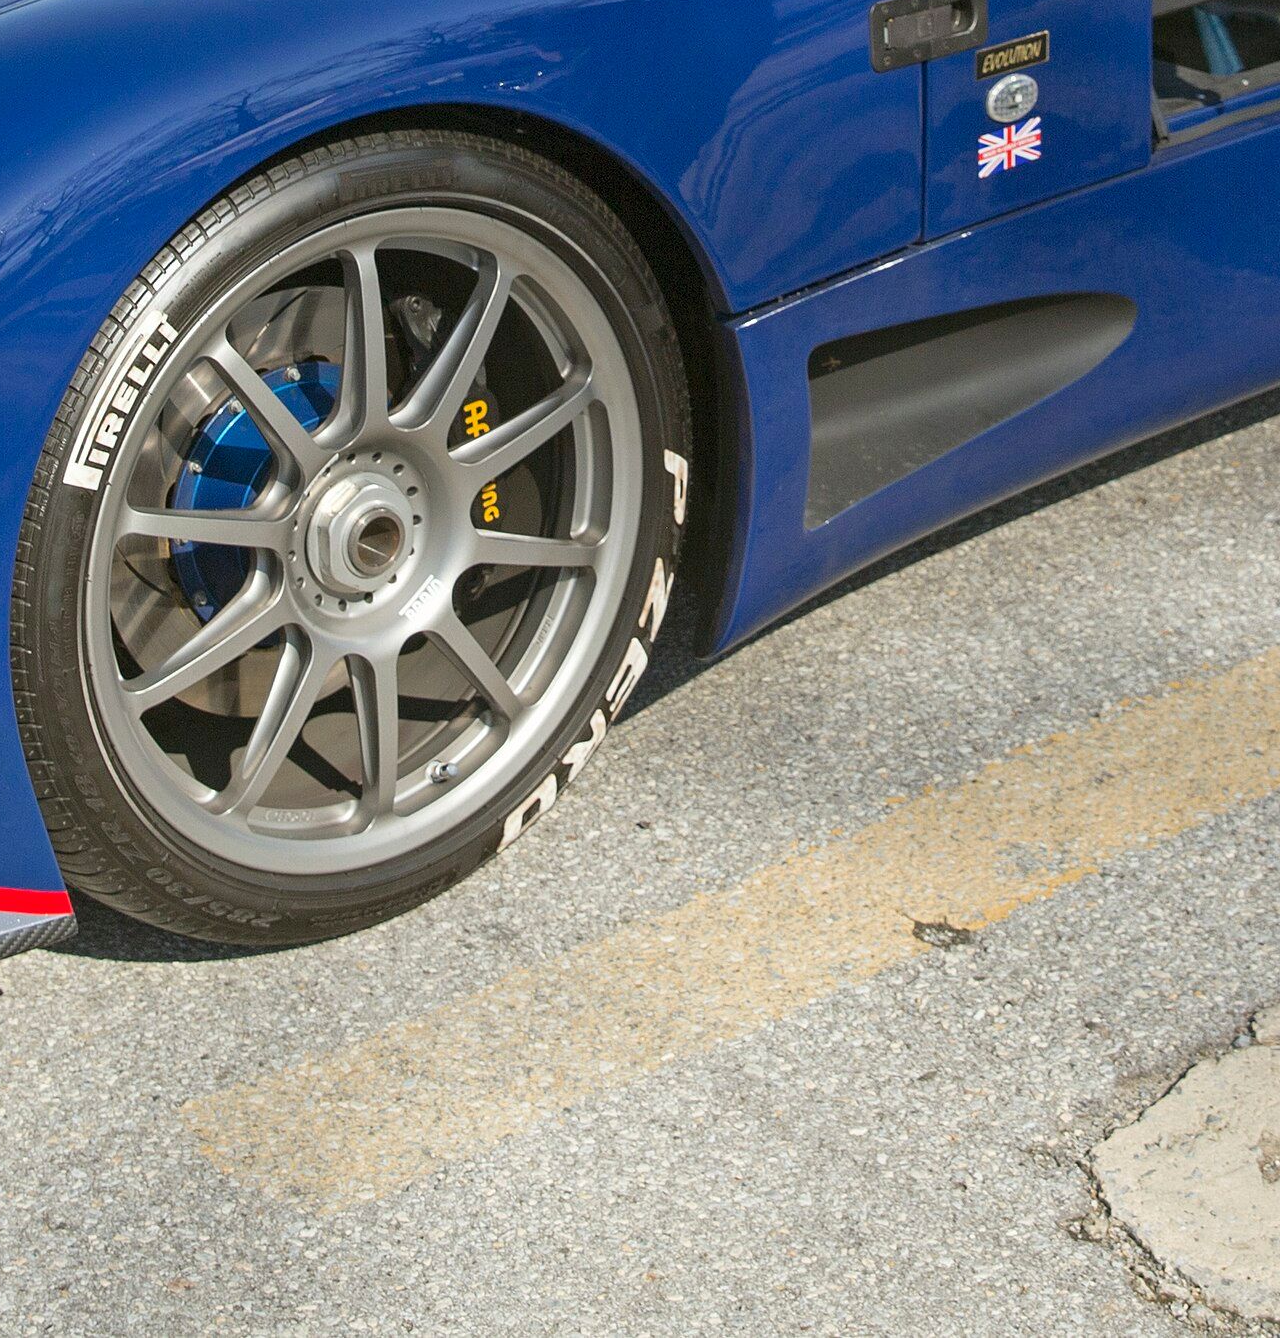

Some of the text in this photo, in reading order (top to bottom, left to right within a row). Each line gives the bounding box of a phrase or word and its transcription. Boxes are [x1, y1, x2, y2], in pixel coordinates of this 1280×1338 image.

[982, 39, 1042, 74] EVOLUTION
[63, 312, 179, 491] PIRELLI
[497, 449, 689, 854] P ZERO
